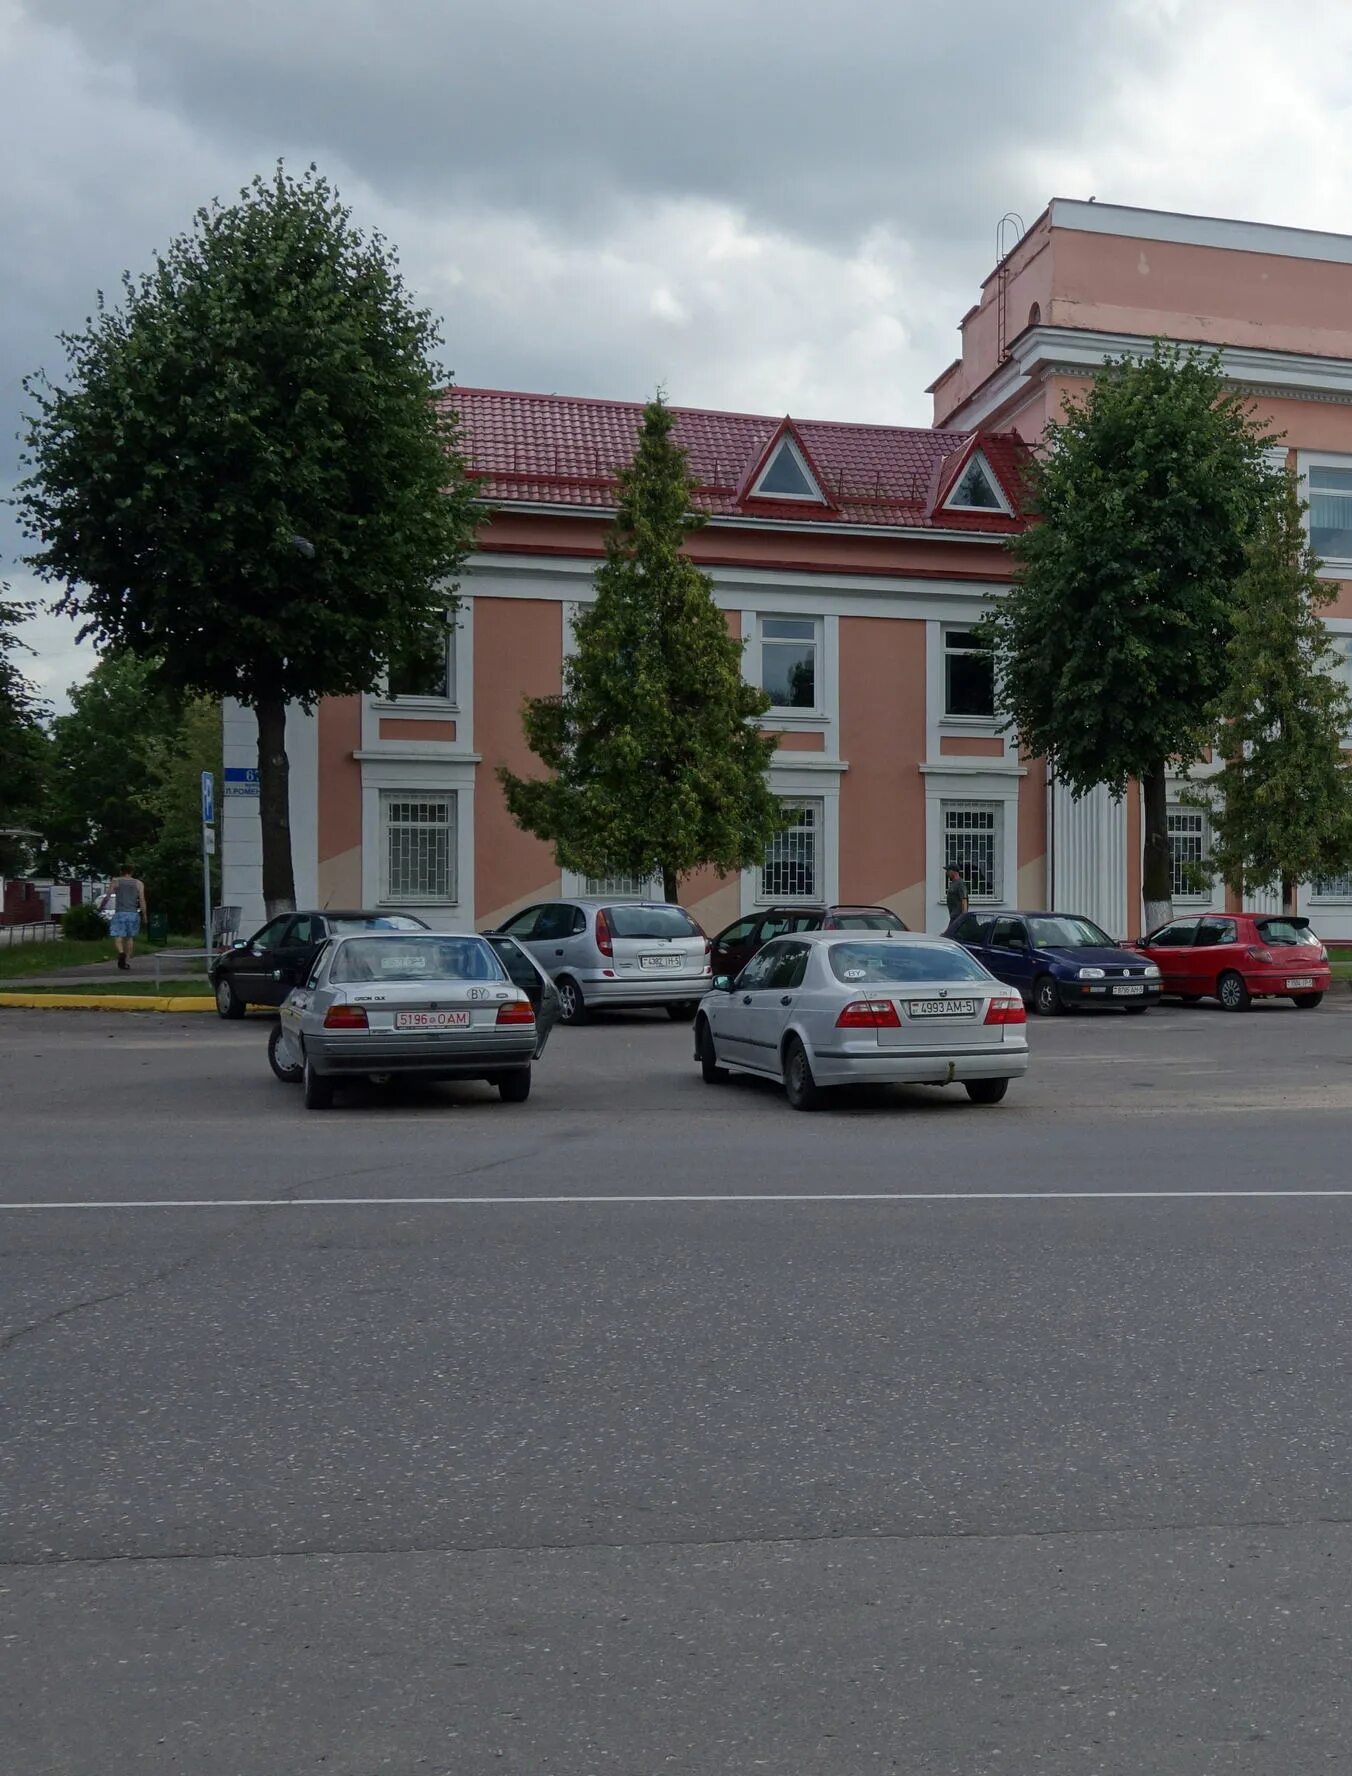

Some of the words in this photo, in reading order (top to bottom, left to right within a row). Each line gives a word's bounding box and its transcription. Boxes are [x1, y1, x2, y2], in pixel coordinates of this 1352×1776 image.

[471, 989, 485, 999] BY
[921, 1000, 944, 1014] 4993
[946, 1000, 972, 1013] AM-5
[400, 1014, 427, 1025] 5196
